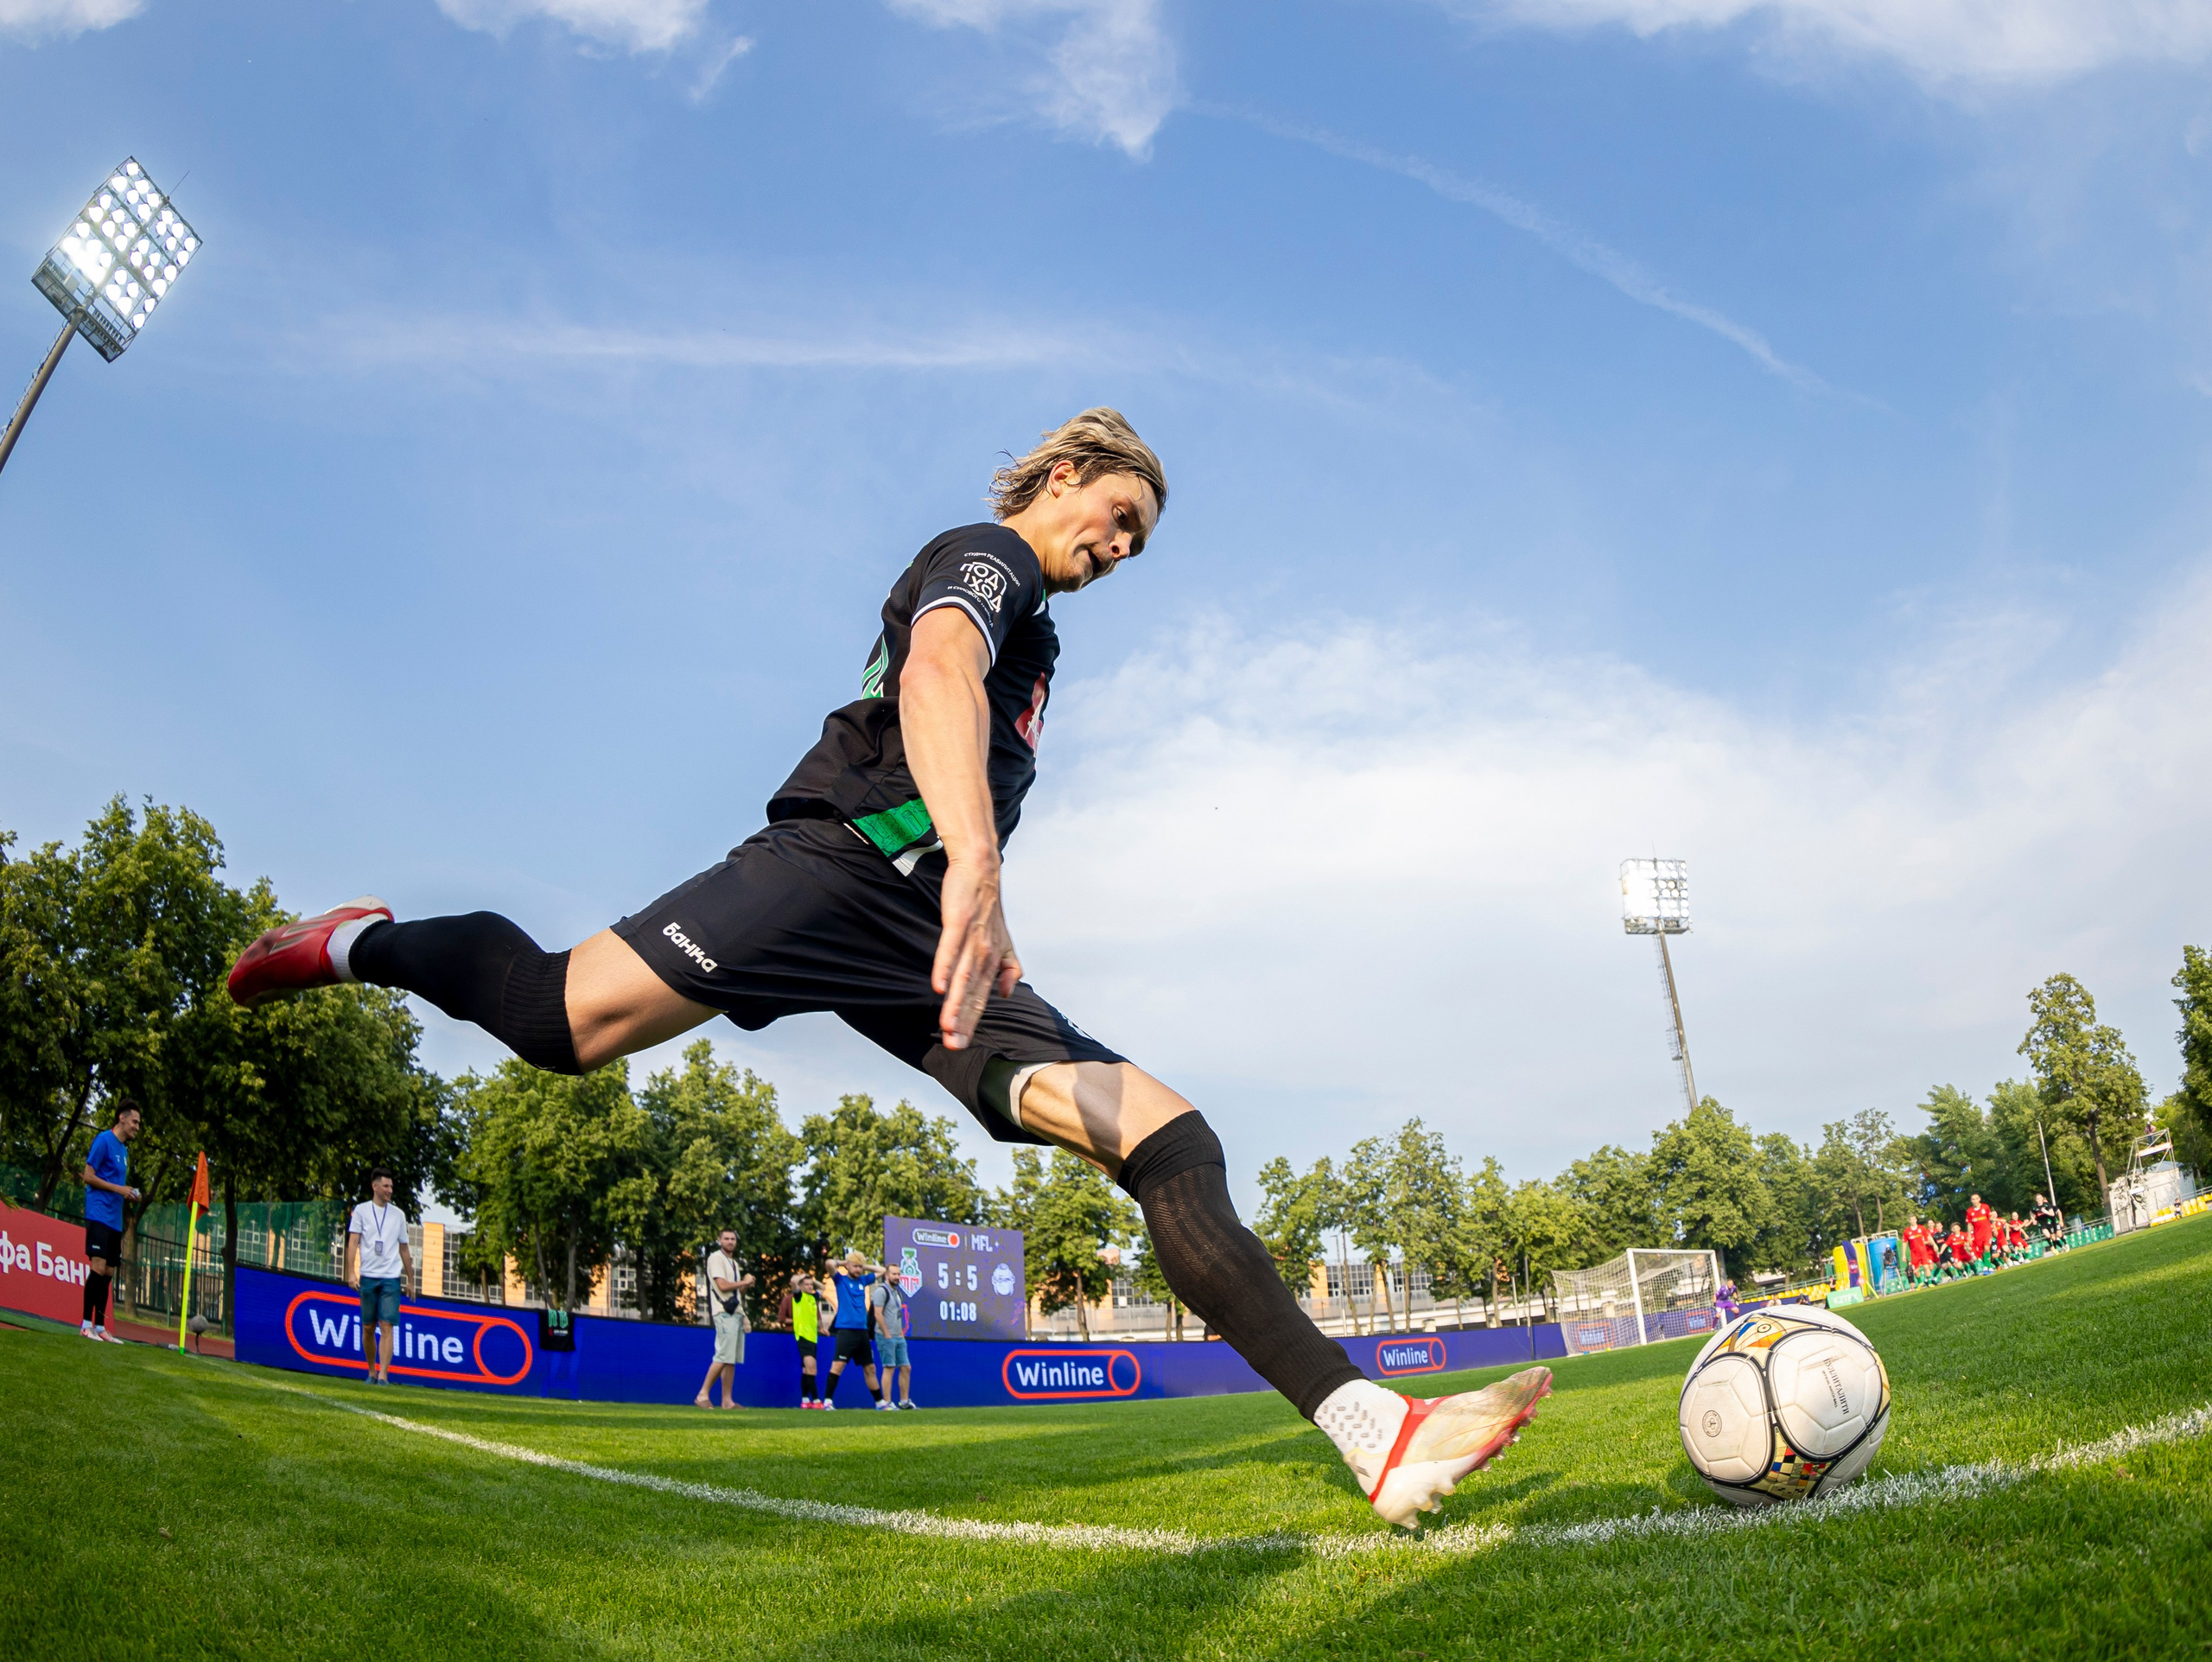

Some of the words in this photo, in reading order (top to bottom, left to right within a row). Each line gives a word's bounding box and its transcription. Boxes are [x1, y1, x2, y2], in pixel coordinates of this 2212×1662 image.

[960, 563, 999, 591] ПОД
[987, 553, 1020, 587] РЕАБИЛИТАЦИИ
[662, 921, 718, 973] банка
[917, 1231, 948, 1244] Winline
[970, 1233, 994, 1252] MFL
[938, 1262, 949, 1289] 5
[966, 1264, 977, 1291] 5
[939, 1300, 977, 1322] 01:08
[309, 1308, 464, 1364] Wiline
[1382, 1347, 1428, 1367] Winline
[1016, 1361, 1104, 1387] Winline
